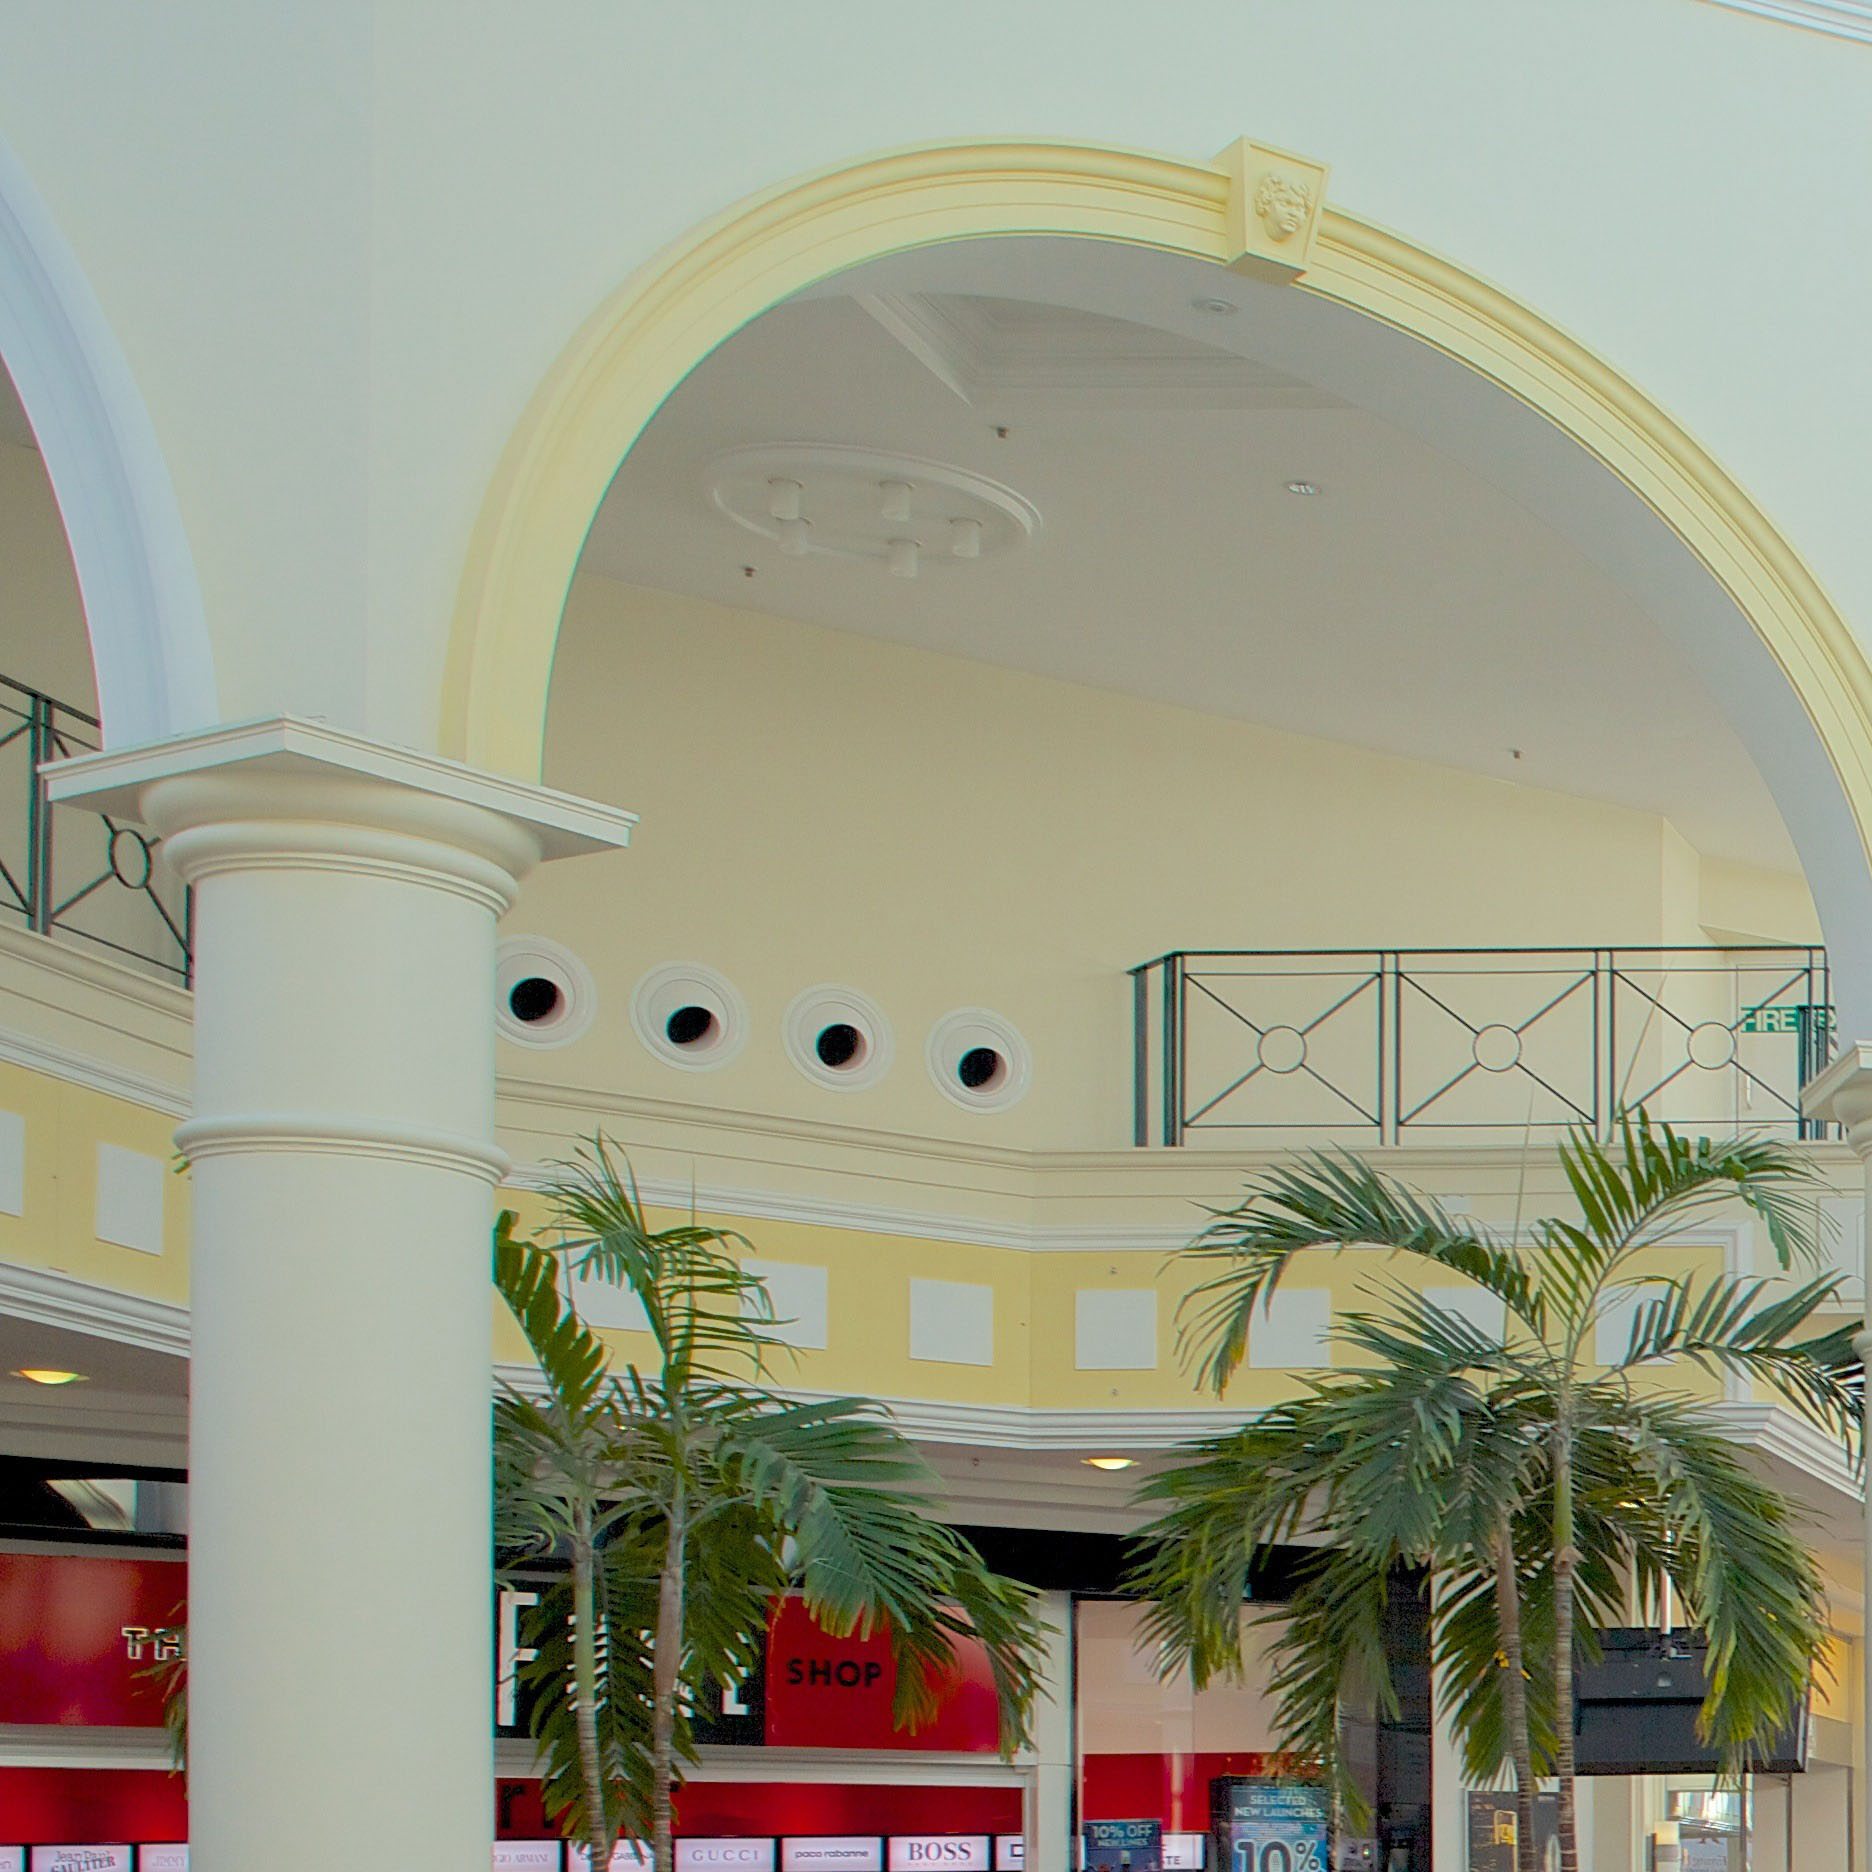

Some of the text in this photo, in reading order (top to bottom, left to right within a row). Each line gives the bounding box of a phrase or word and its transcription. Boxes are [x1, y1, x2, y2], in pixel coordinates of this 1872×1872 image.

[786, 1657, 883, 1690] SHOP
[1250, 1794, 1307, 1807] SELECTED
[1234, 1807, 1260, 1818] NEW
[1093, 1824, 1153, 1839] 10% OFF
[691, 1849, 759, 1862] GUCCI
[794, 1848, 870, 1861] paco rabanne
[908, 1841, 972, 1862] BOSS
